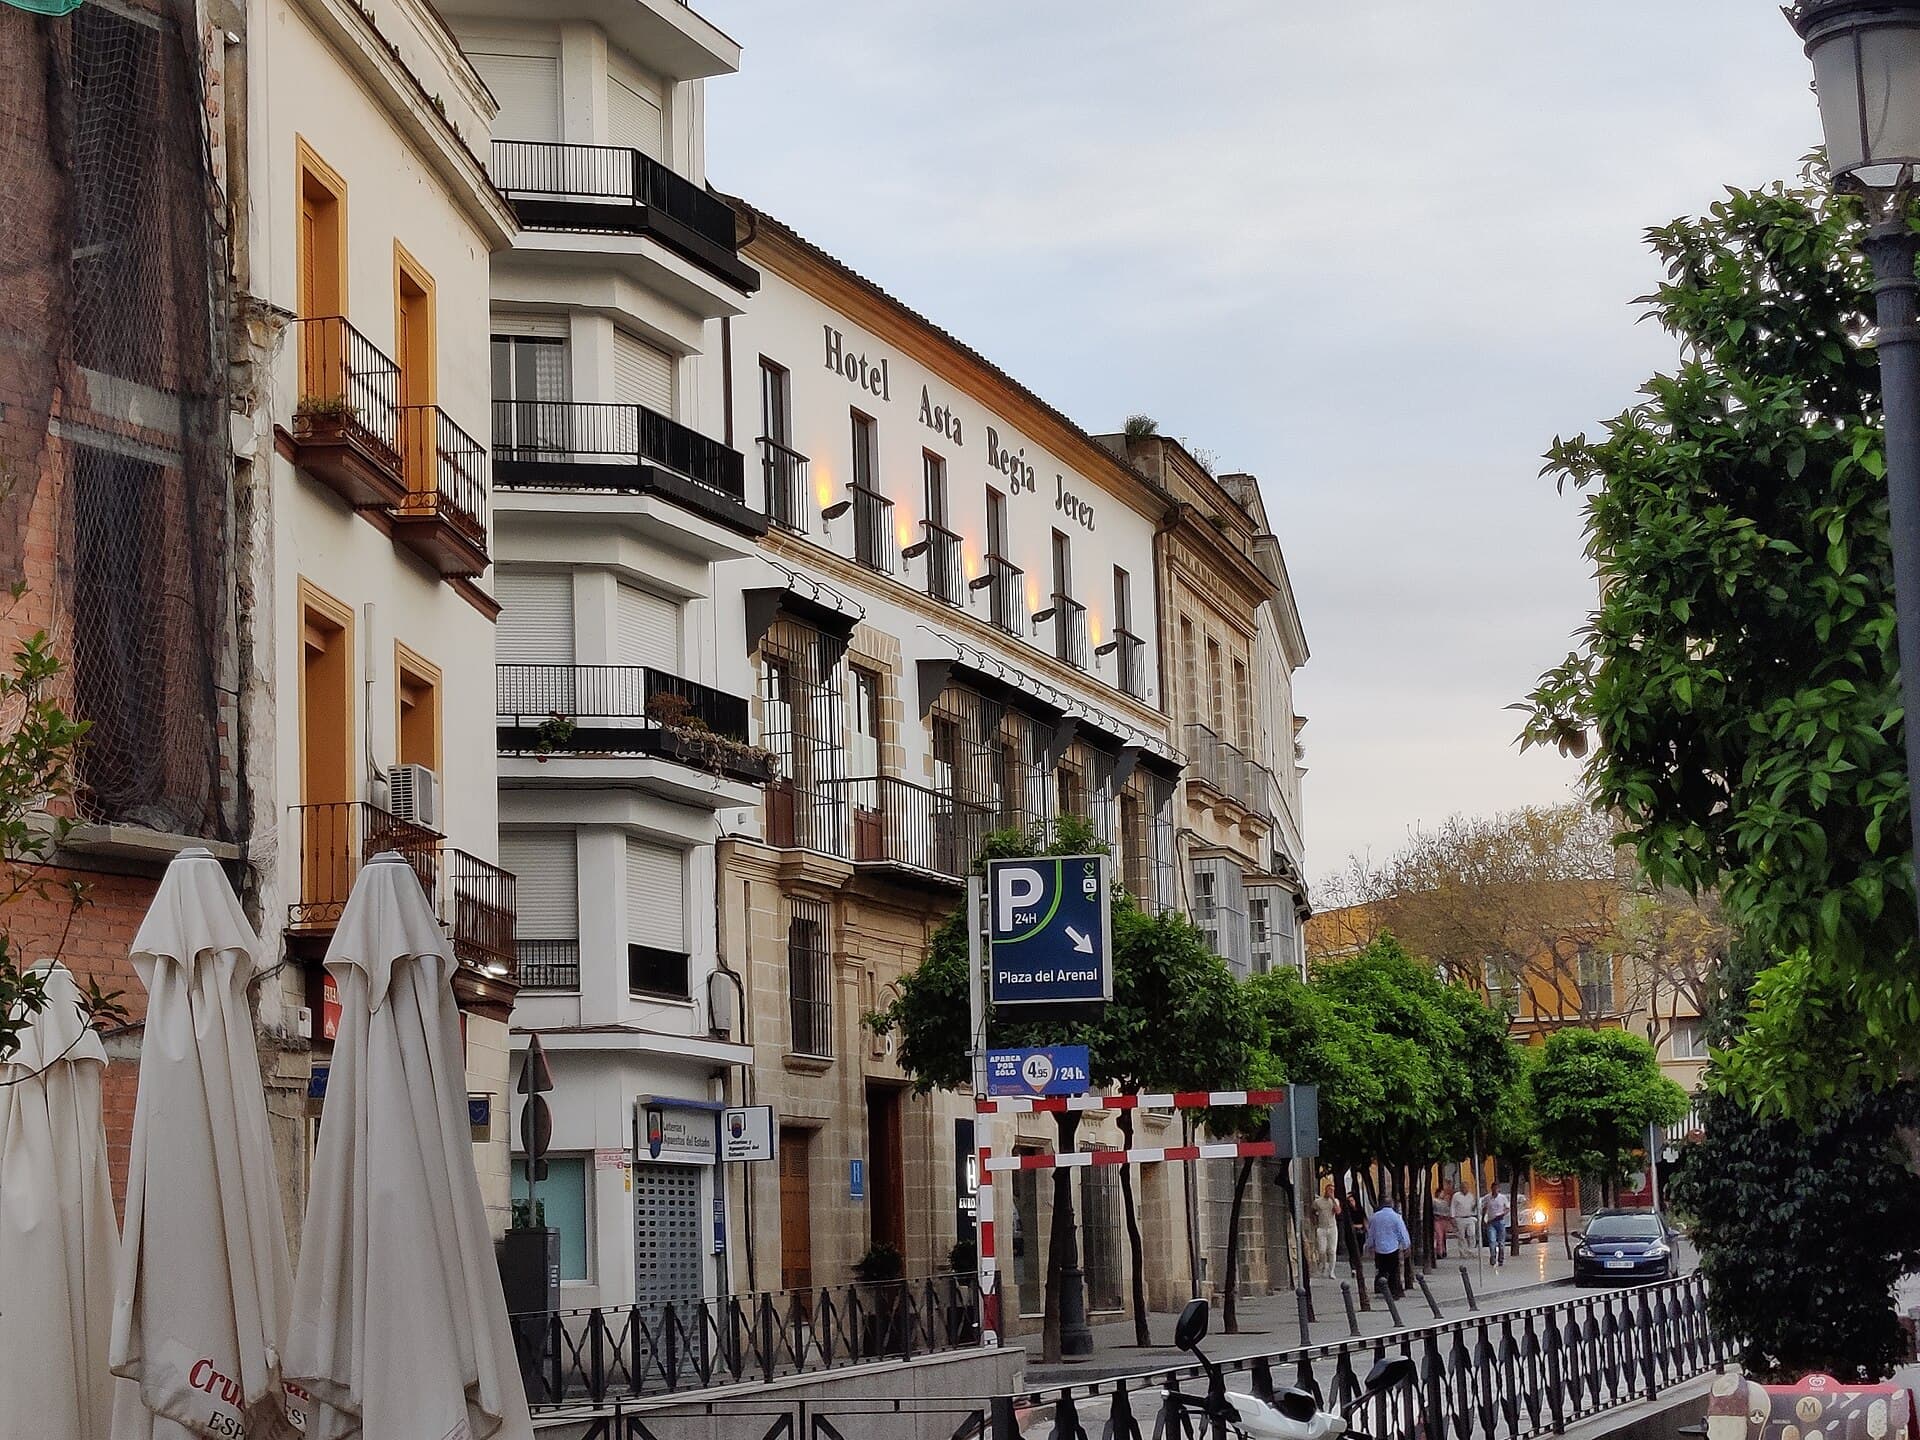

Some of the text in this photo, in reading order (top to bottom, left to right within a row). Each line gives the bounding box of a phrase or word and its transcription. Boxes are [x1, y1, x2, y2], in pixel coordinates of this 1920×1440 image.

[824, 325, 1096, 531] Hotel Asta Regia Jerez
[999, 868, 1044, 932] P
[1015, 913, 1037, 925] 24H
[999, 968, 1098, 984] Plaza del Arenal
[853, 1162, 860, 1182] H
[189, 1359, 246, 1412] Cru
[1802, 1401, 1816, 1414] M
